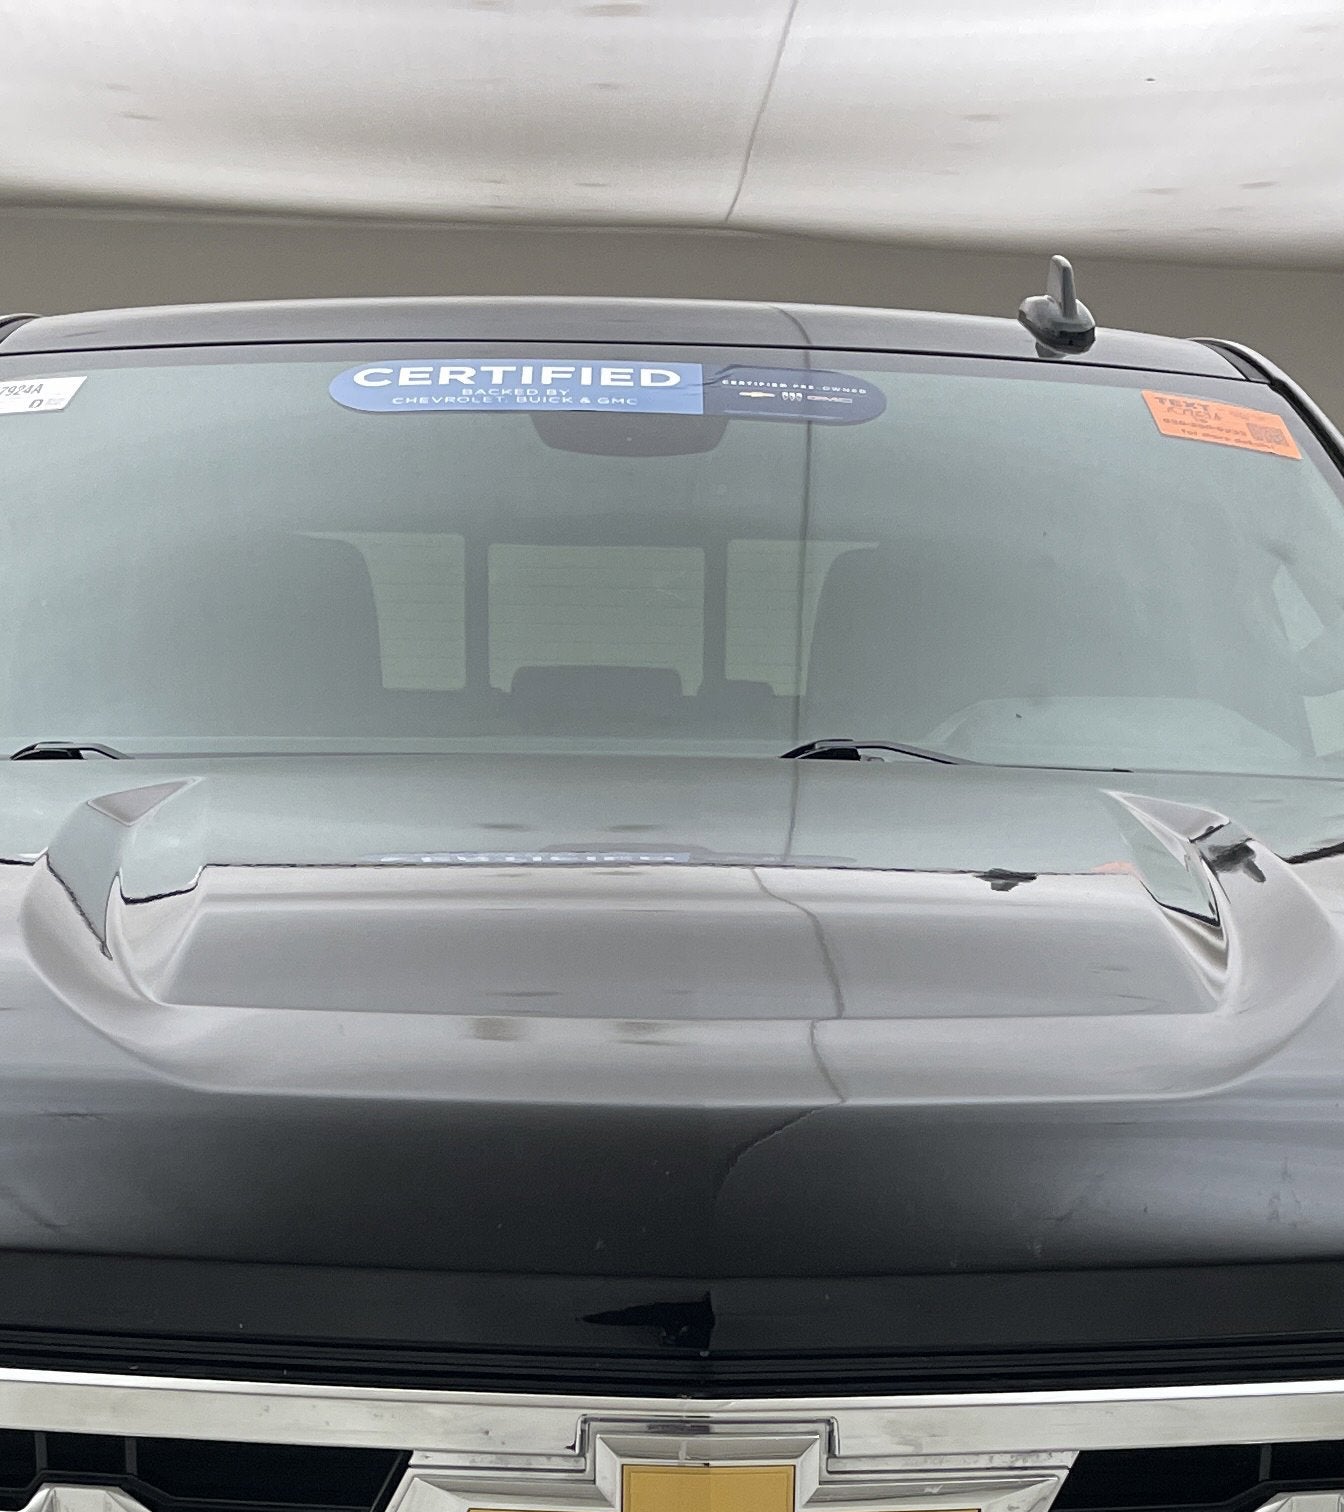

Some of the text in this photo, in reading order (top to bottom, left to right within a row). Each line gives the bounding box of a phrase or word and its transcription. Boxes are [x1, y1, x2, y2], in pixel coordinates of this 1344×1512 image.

[353, 366, 681, 387] CERTIFIED
[462, 388, 570, 396] BACKED BY
[516, 396, 573, 404] BUICK
[597, 397, 637, 406] GMC
